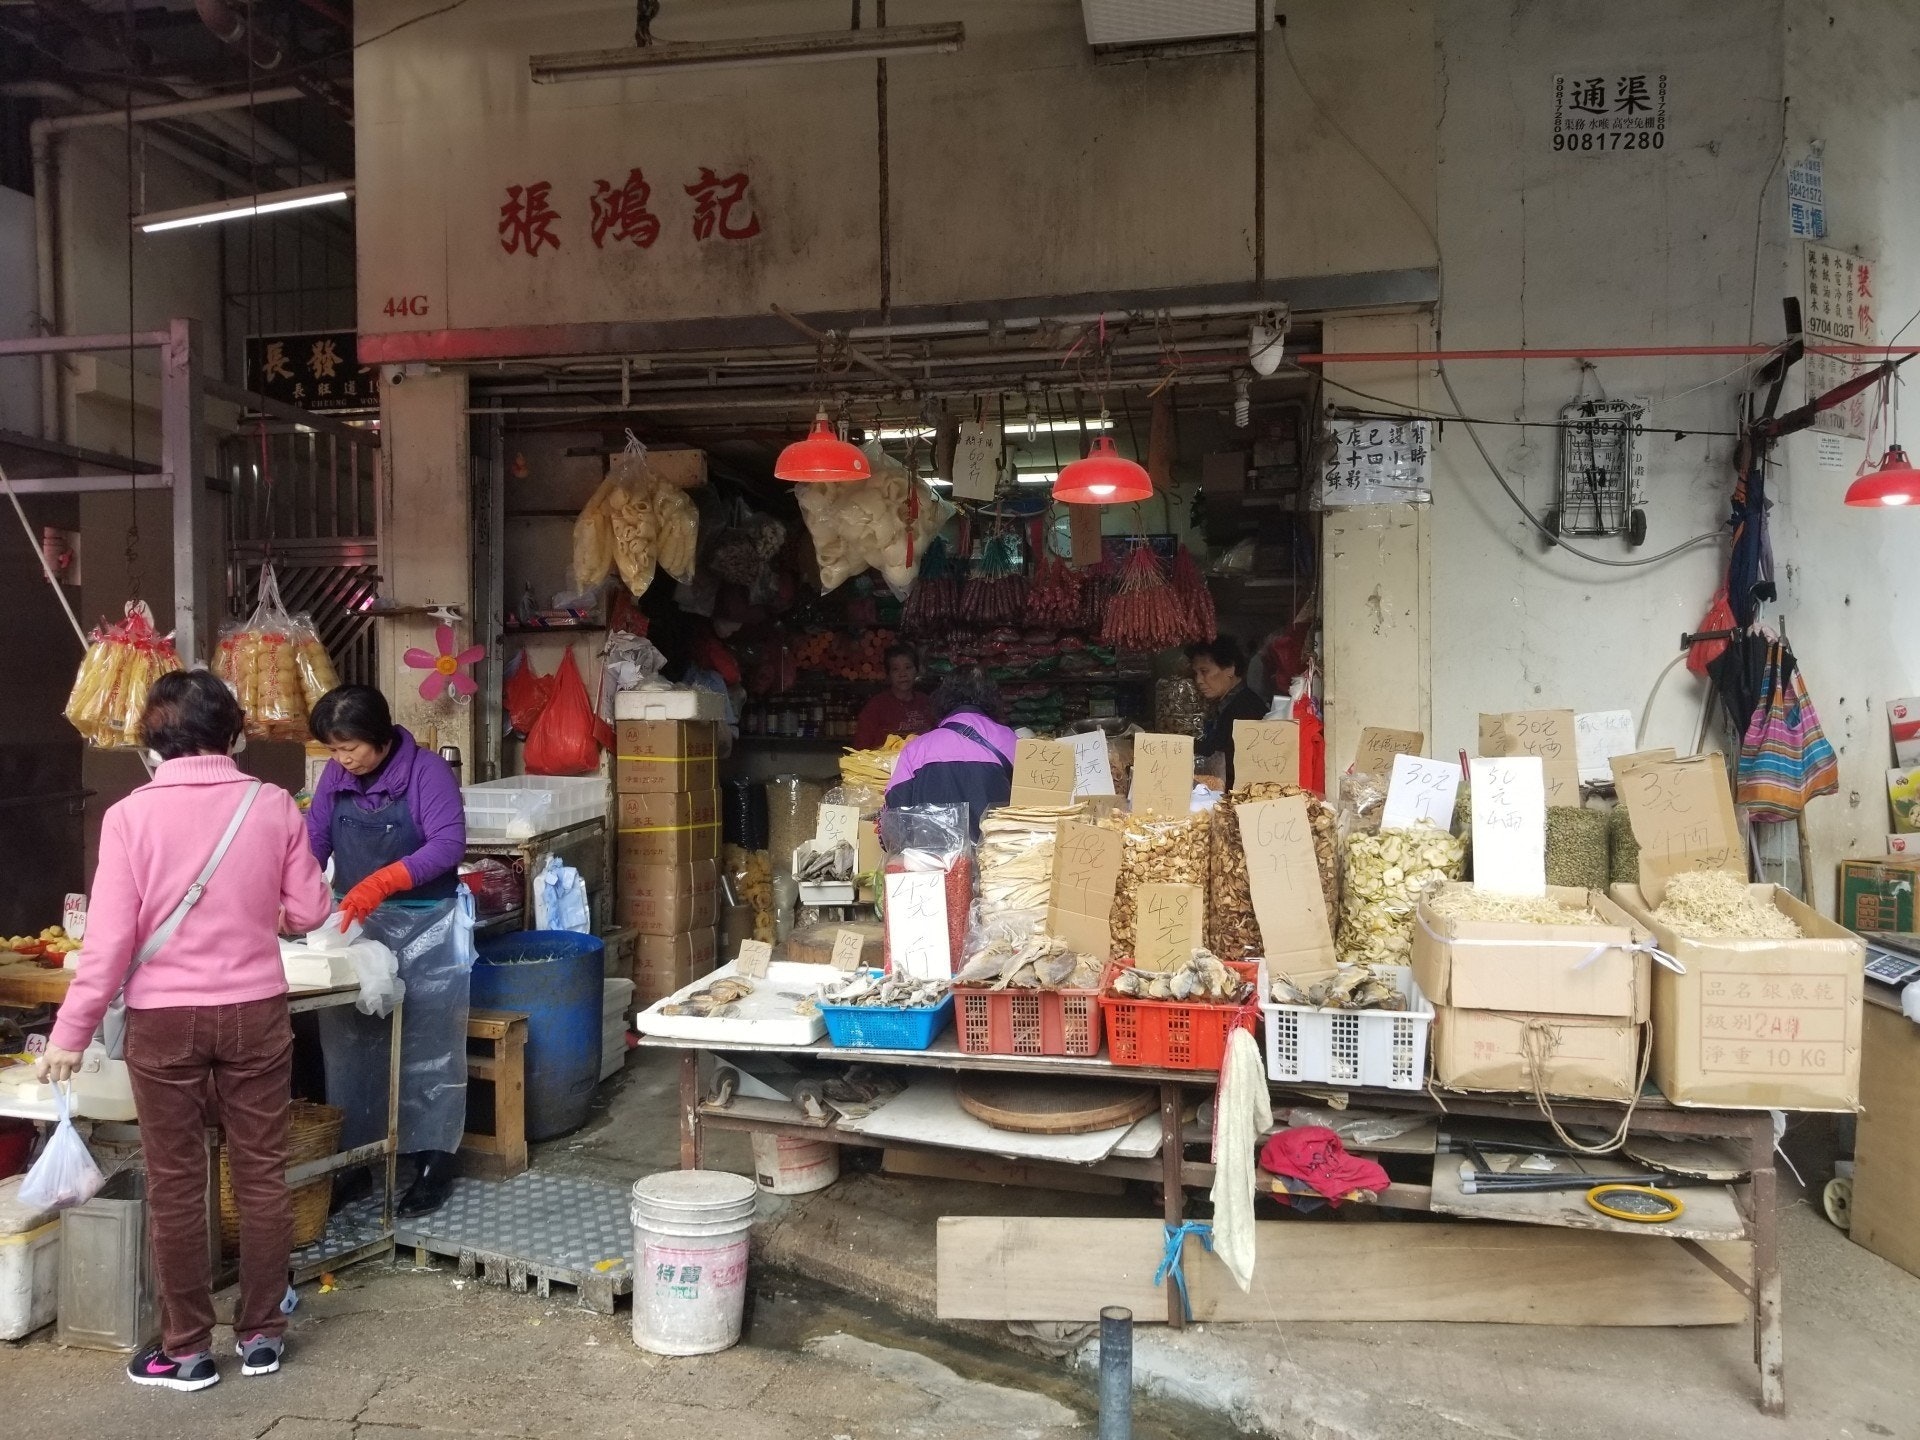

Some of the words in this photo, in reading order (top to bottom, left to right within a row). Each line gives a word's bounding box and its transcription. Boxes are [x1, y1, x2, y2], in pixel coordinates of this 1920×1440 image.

[1554, 77, 1564, 133] 90817280
[1569, 75, 1653, 115] 通渠
[1657, 74, 1667, 130] 90817280
[1553, 131, 1665, 151] 90817280
[1789, 182, 1822, 202] 96421572
[499, 167, 760, 257] 張鴻記
[383, 296, 429, 316] 44G
[1810, 317, 1832, 334] 9704
[1833, 322, 1855, 339] 0387
[263, 340, 371, 382] 長發
[311, 399, 347, 407] CHEUNG
[1517, 715, 1558, 737] 30元
[1148, 894, 1189, 925] 48
[1705, 1014, 1751, 1031] 級別
[1767, 1049, 1791, 1066] 10
[1801, 1049, 1826, 1067] KG
